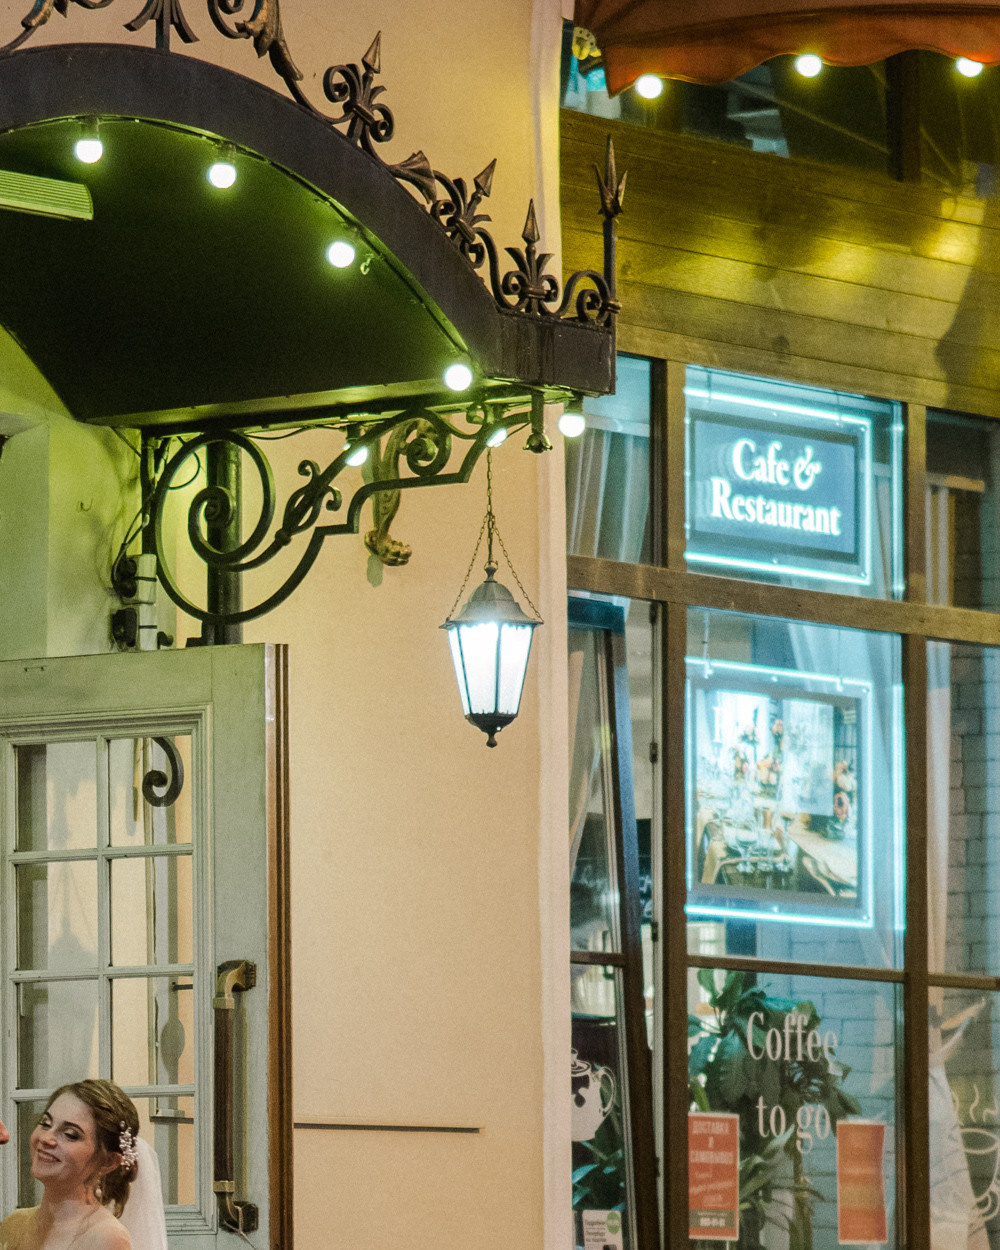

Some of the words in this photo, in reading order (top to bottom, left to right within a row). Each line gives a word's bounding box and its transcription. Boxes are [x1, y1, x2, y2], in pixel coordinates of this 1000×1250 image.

[732, 437, 790, 486] Cafe
[793, 444, 823, 491] &
[710, 475, 842, 537] Restaurant
[746, 1011, 839, 1063] Coffee
[756, 1096, 787, 1138] to
[796, 1105, 831, 1155] go
